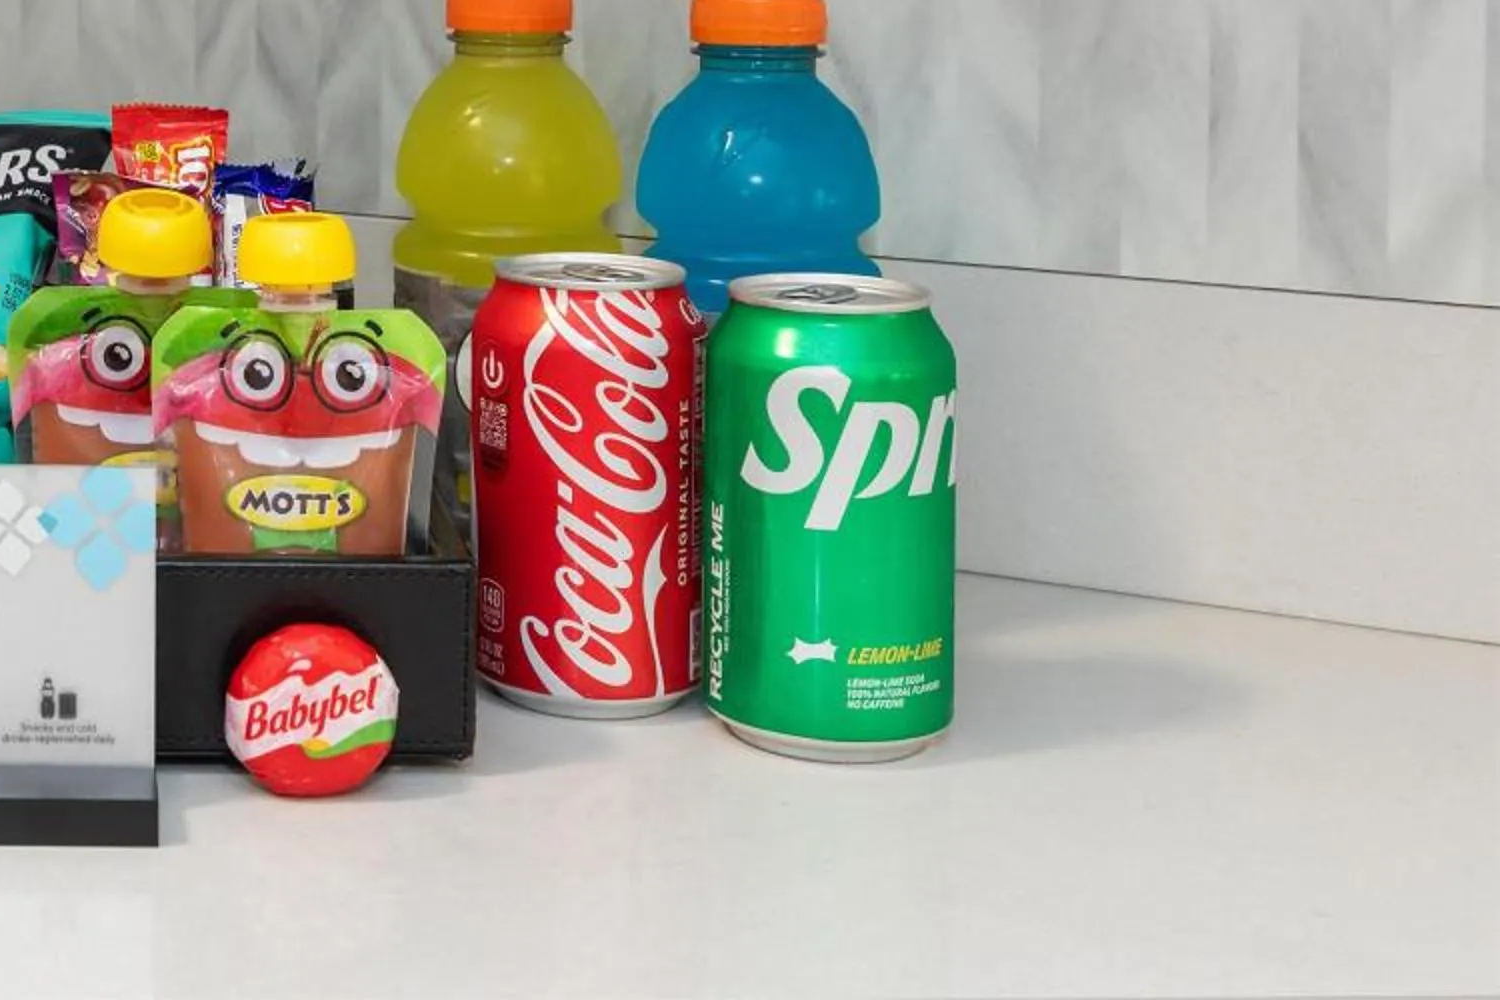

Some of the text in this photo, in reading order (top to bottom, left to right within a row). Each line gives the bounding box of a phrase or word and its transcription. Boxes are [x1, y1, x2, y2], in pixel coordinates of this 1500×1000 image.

[677, 399, 690, 587] ORIGINAL TASTE
[708, 500, 725, 702] RECYCLE ME
[847, 637, 943, 665] LEMON-LIME
[244, 675, 380, 738] Babybel
